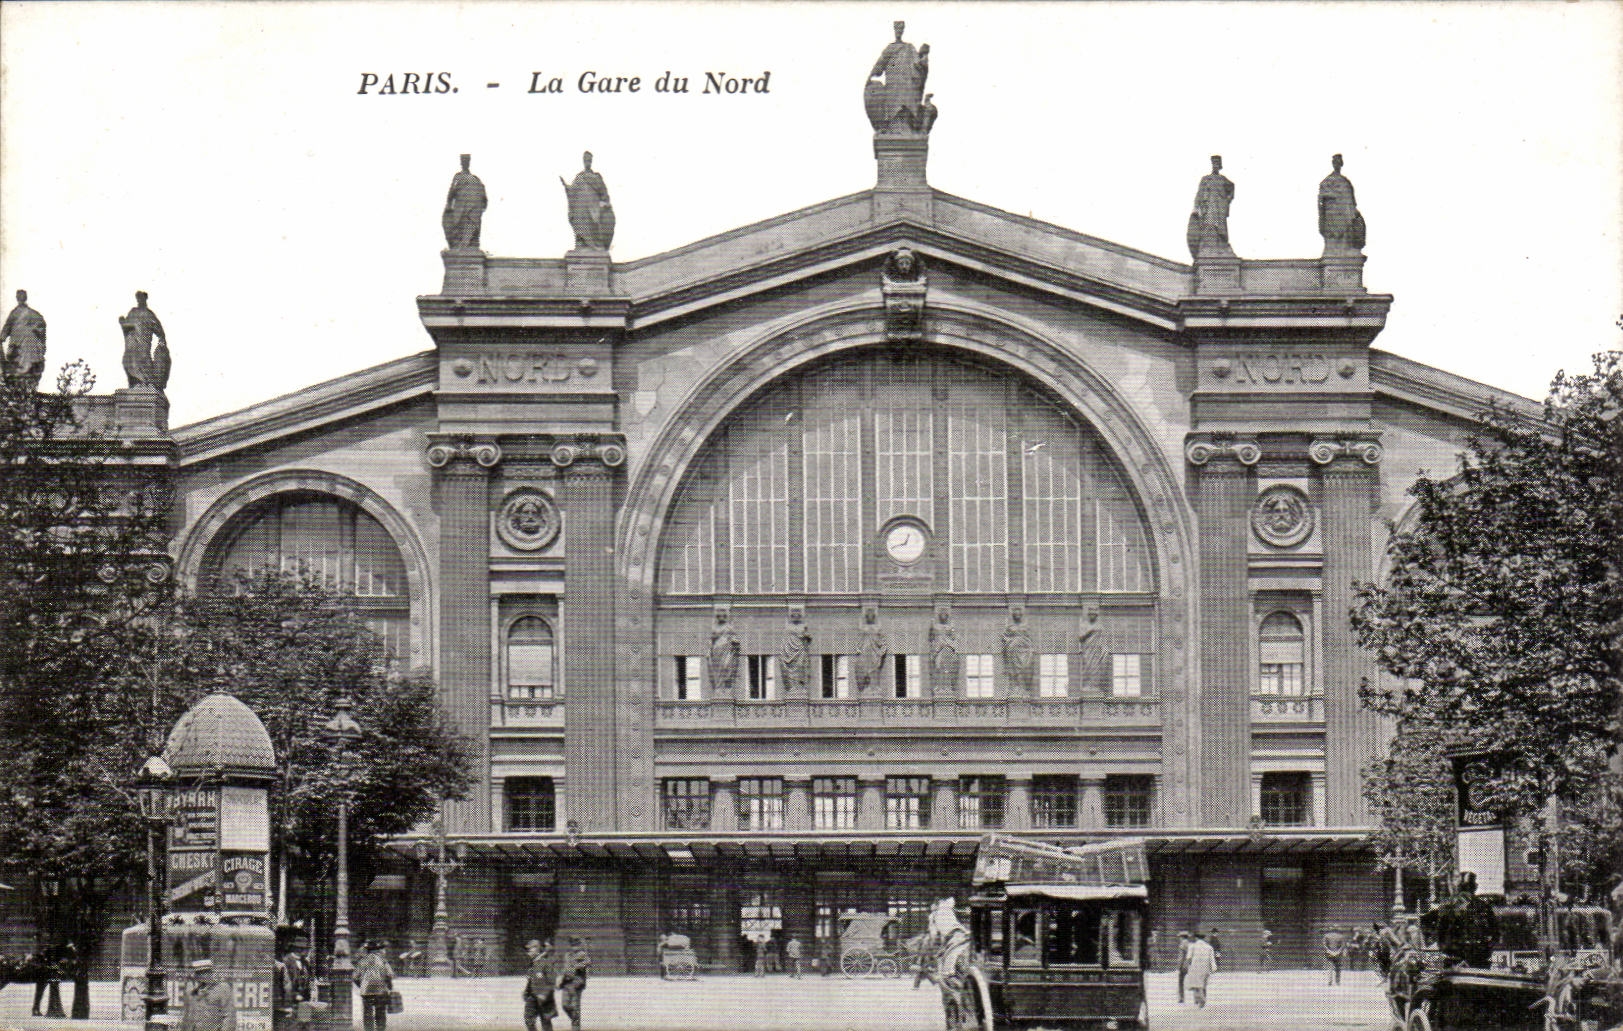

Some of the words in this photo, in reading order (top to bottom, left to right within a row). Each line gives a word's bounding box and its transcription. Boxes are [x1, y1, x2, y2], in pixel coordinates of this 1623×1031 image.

[477, 354, 571, 383] NORD
[1236, 354, 1329, 384] NORD
[223, 856, 263, 874] CIRAGE
